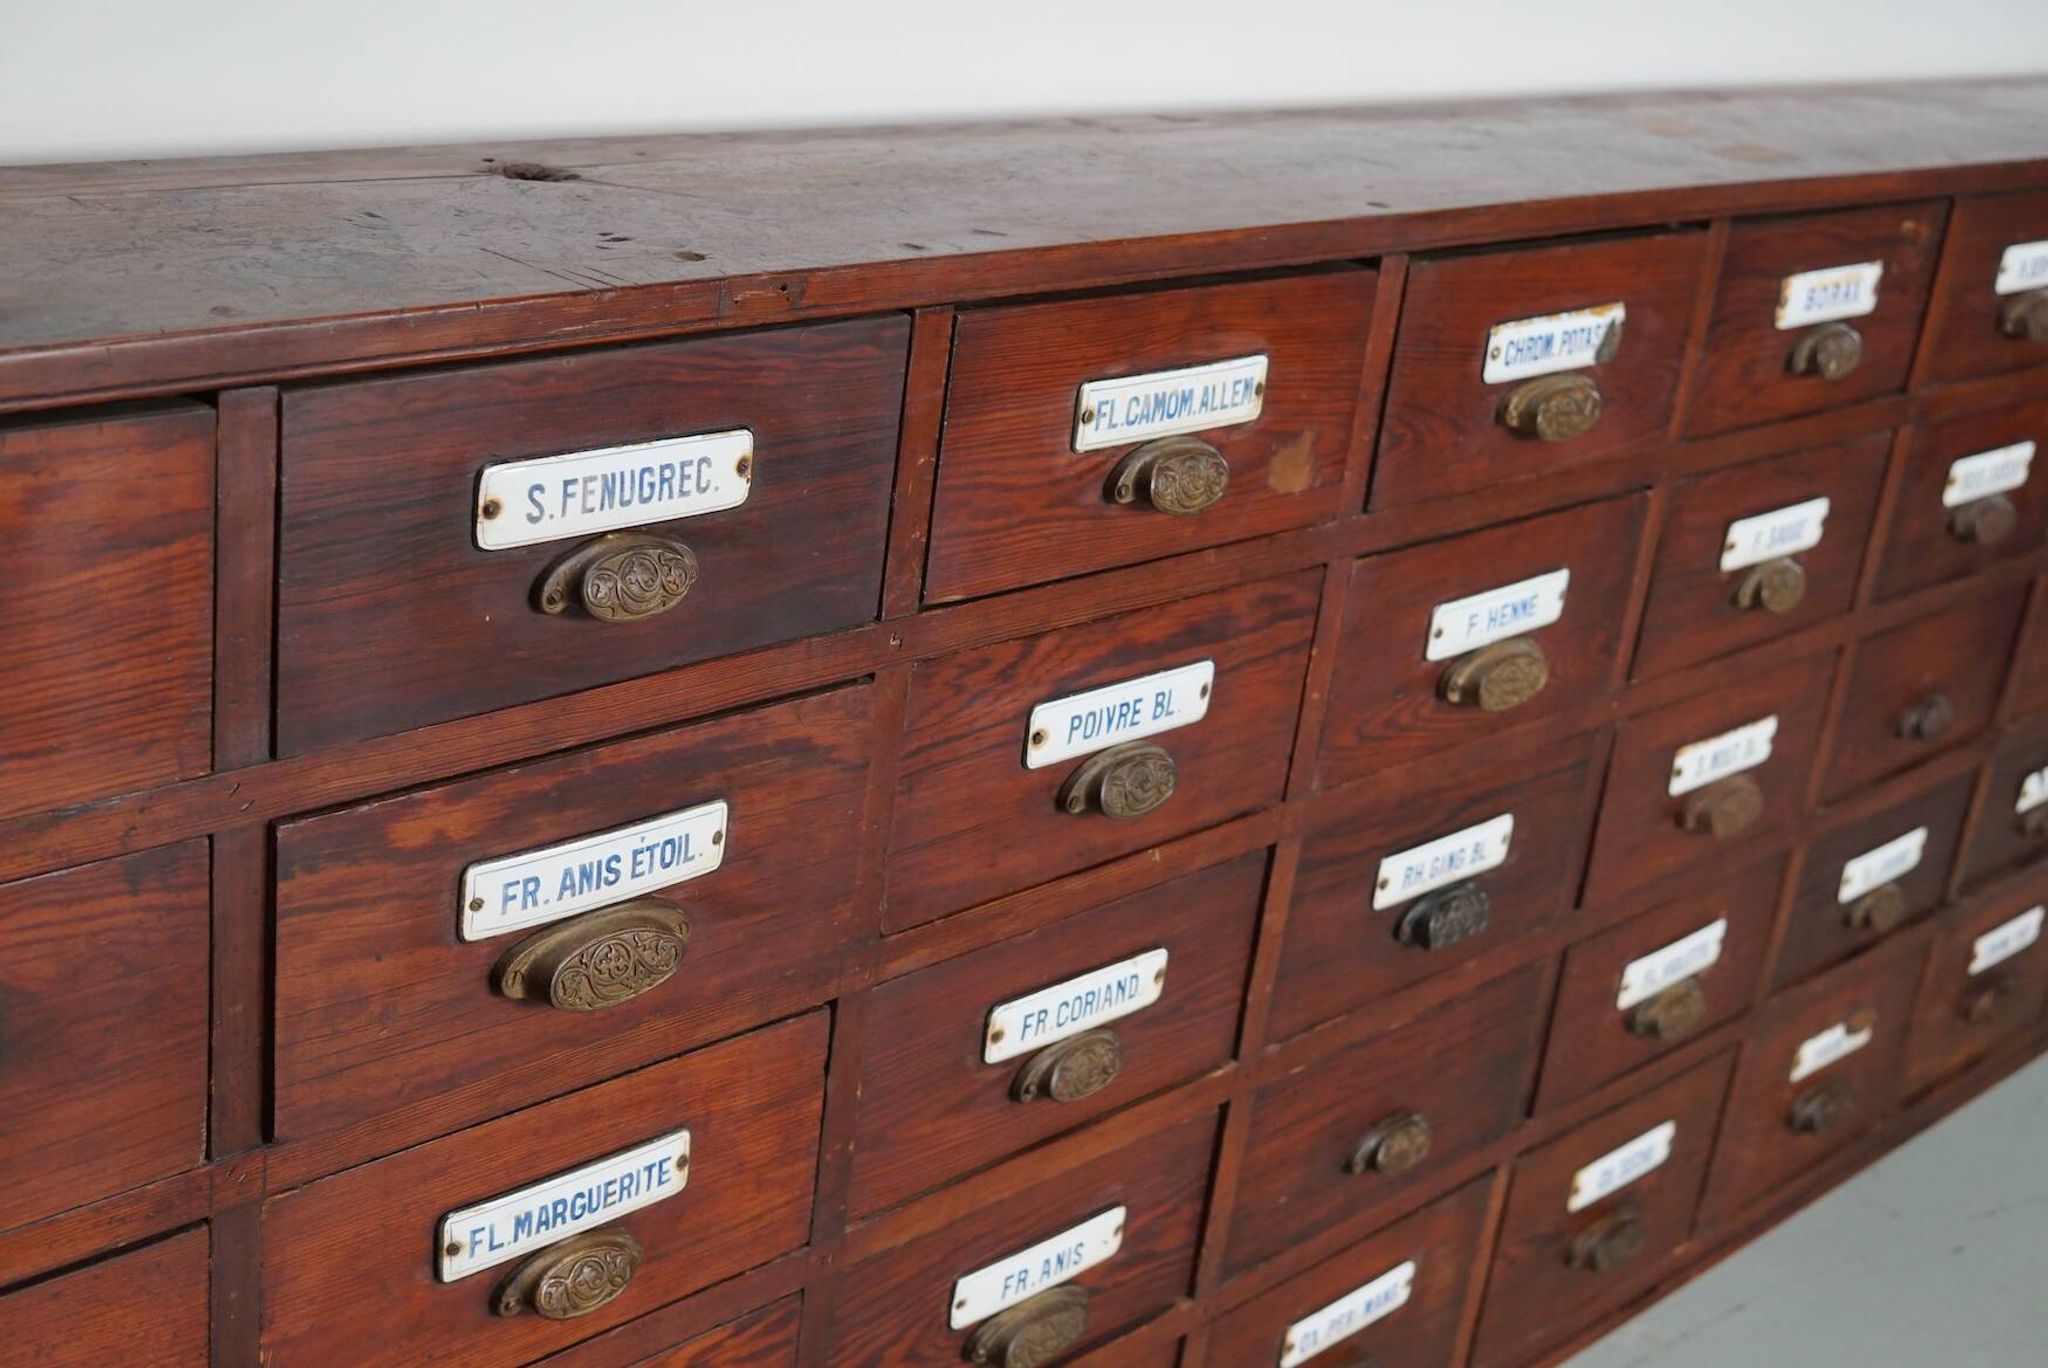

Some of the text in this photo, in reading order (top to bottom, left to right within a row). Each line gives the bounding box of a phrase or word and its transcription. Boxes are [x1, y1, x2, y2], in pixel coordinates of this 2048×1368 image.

[1066, 697, 1144, 745] POIVRE
[500, 876, 551, 916] FR.
[556, 853, 622, 902] ANIS
